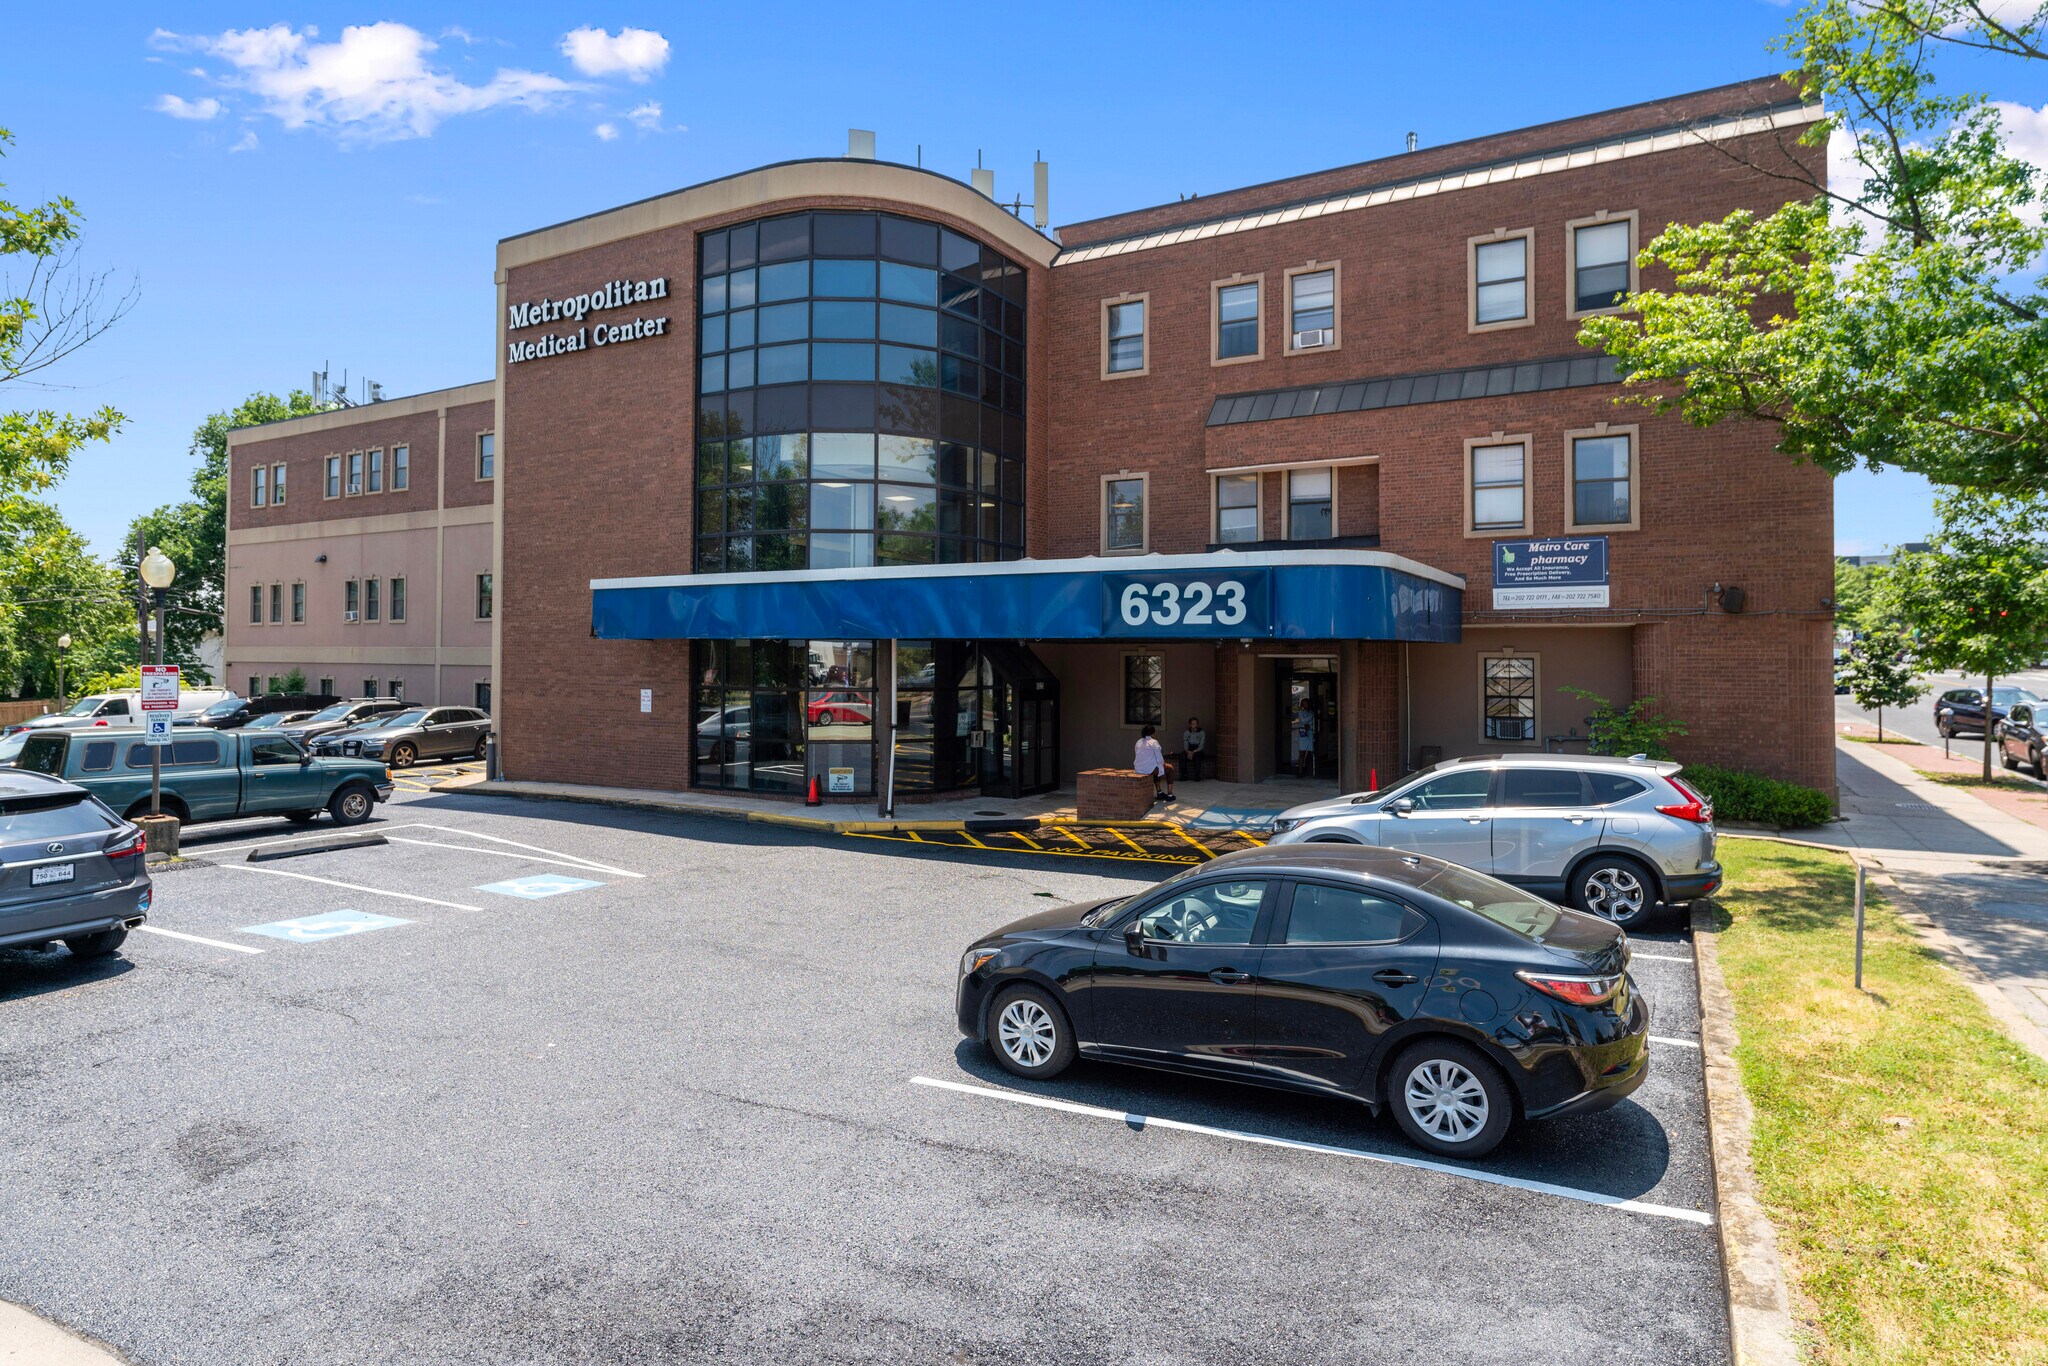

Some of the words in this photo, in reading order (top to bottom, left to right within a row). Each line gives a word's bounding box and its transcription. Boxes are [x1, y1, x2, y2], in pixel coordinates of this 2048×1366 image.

[509, 277, 668, 329] Metropolitan
[508, 327, 587, 363] Medical
[593, 316, 668, 346] Center
[1528, 543, 1560, 552] Metro
[1564, 541, 1590, 551] Care
[1531, 555, 1588, 566] pharmacy
[1120, 580, 1247, 626] 6323
[1089, 849, 1200, 862] PARKING
